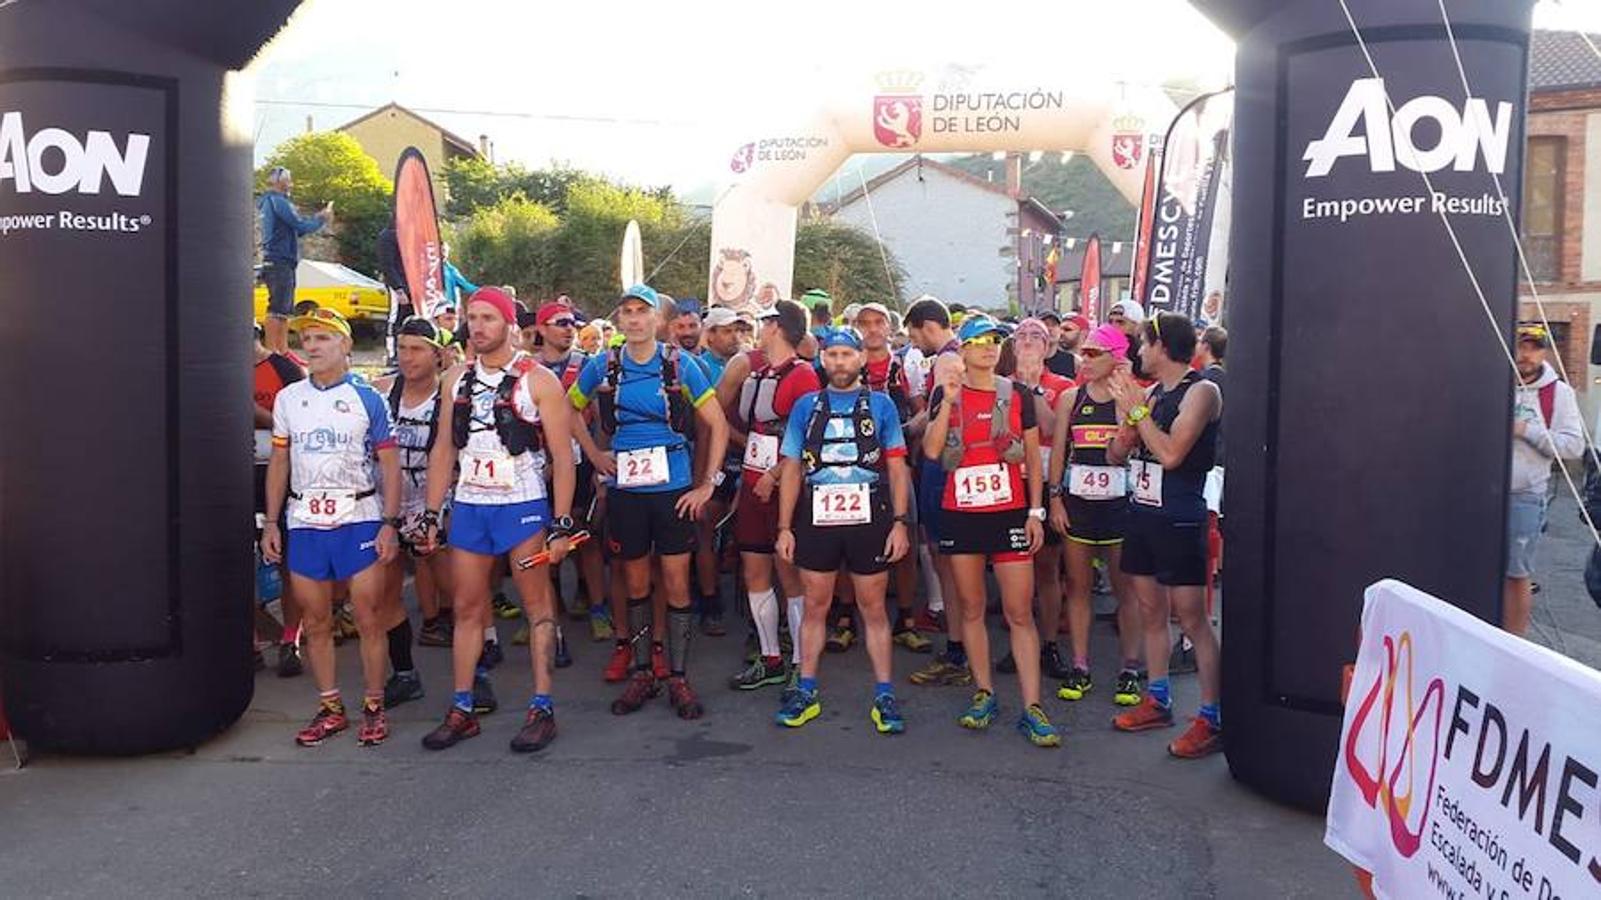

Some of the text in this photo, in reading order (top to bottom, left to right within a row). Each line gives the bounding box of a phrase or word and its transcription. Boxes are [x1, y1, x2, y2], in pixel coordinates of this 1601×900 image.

[933, 88, 1063, 112] DIPUTACIÓN
[933, 112, 1020, 133] DE LEÓN
[759, 137, 829, 150] DIPUTACIÓN
[758, 149, 807, 161] DE LEÓN
[1303, 196, 1425, 222] Empower
[473, 458, 495, 478] 71
[627, 458, 653, 477] 22
[963, 474, 1001, 494] 158
[1083, 472, 1110, 488] 49
[309, 498, 337, 515] 88
[821, 494, 862, 512] 122
[1444, 684, 1601, 884] FDME
[1437, 785, 1508, 871] Federación
[1511, 857, 1533, 893] de
[1431, 821, 1482, 894] Escalada
